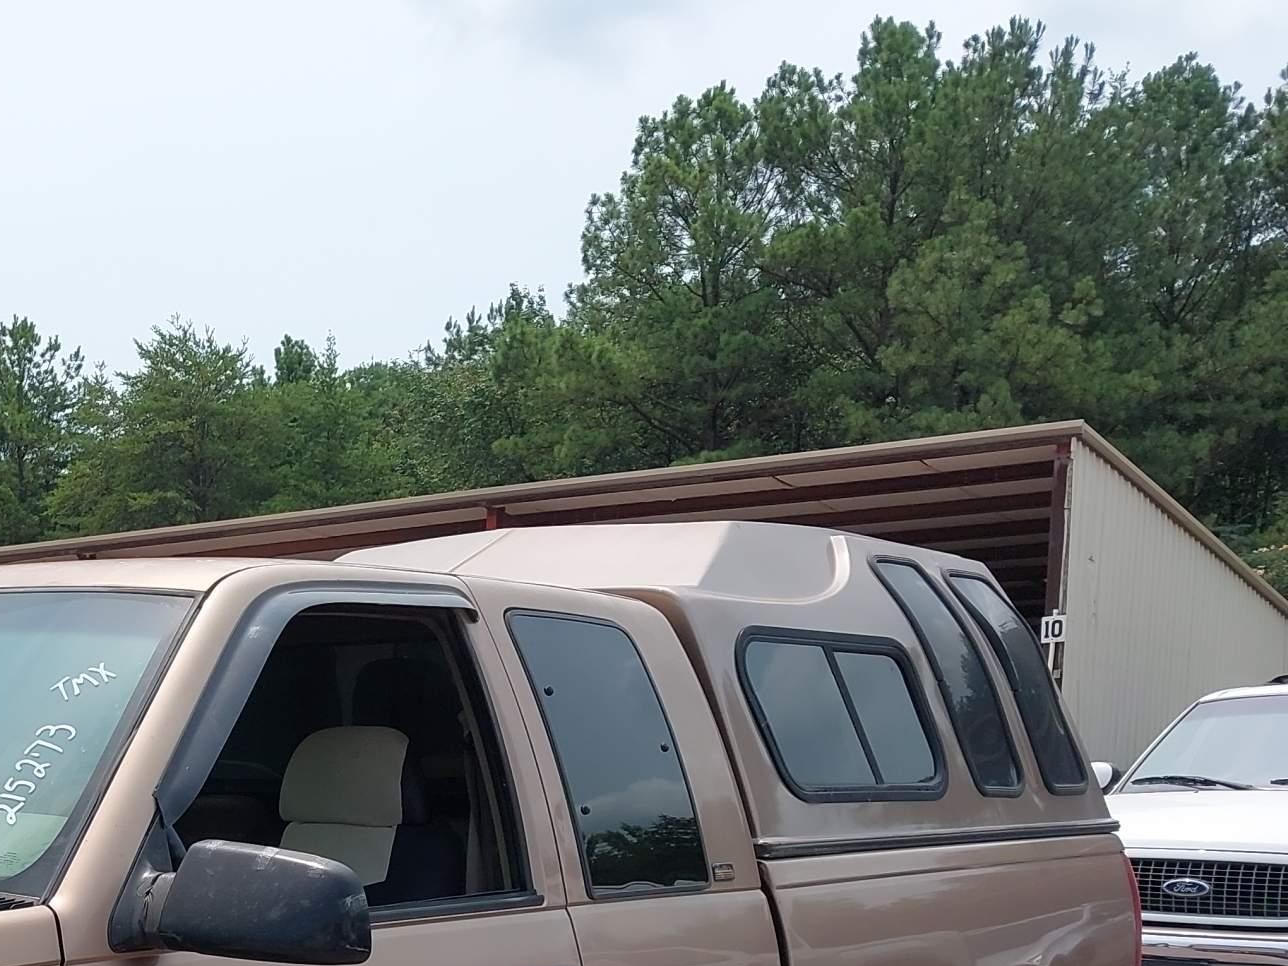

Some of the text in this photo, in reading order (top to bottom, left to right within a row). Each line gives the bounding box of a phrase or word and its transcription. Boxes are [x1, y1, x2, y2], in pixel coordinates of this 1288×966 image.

[1044, 619, 1063, 639] 10
[49, 661, 118, 702] TMX
[1173, 881, 1199, 893] Ford
